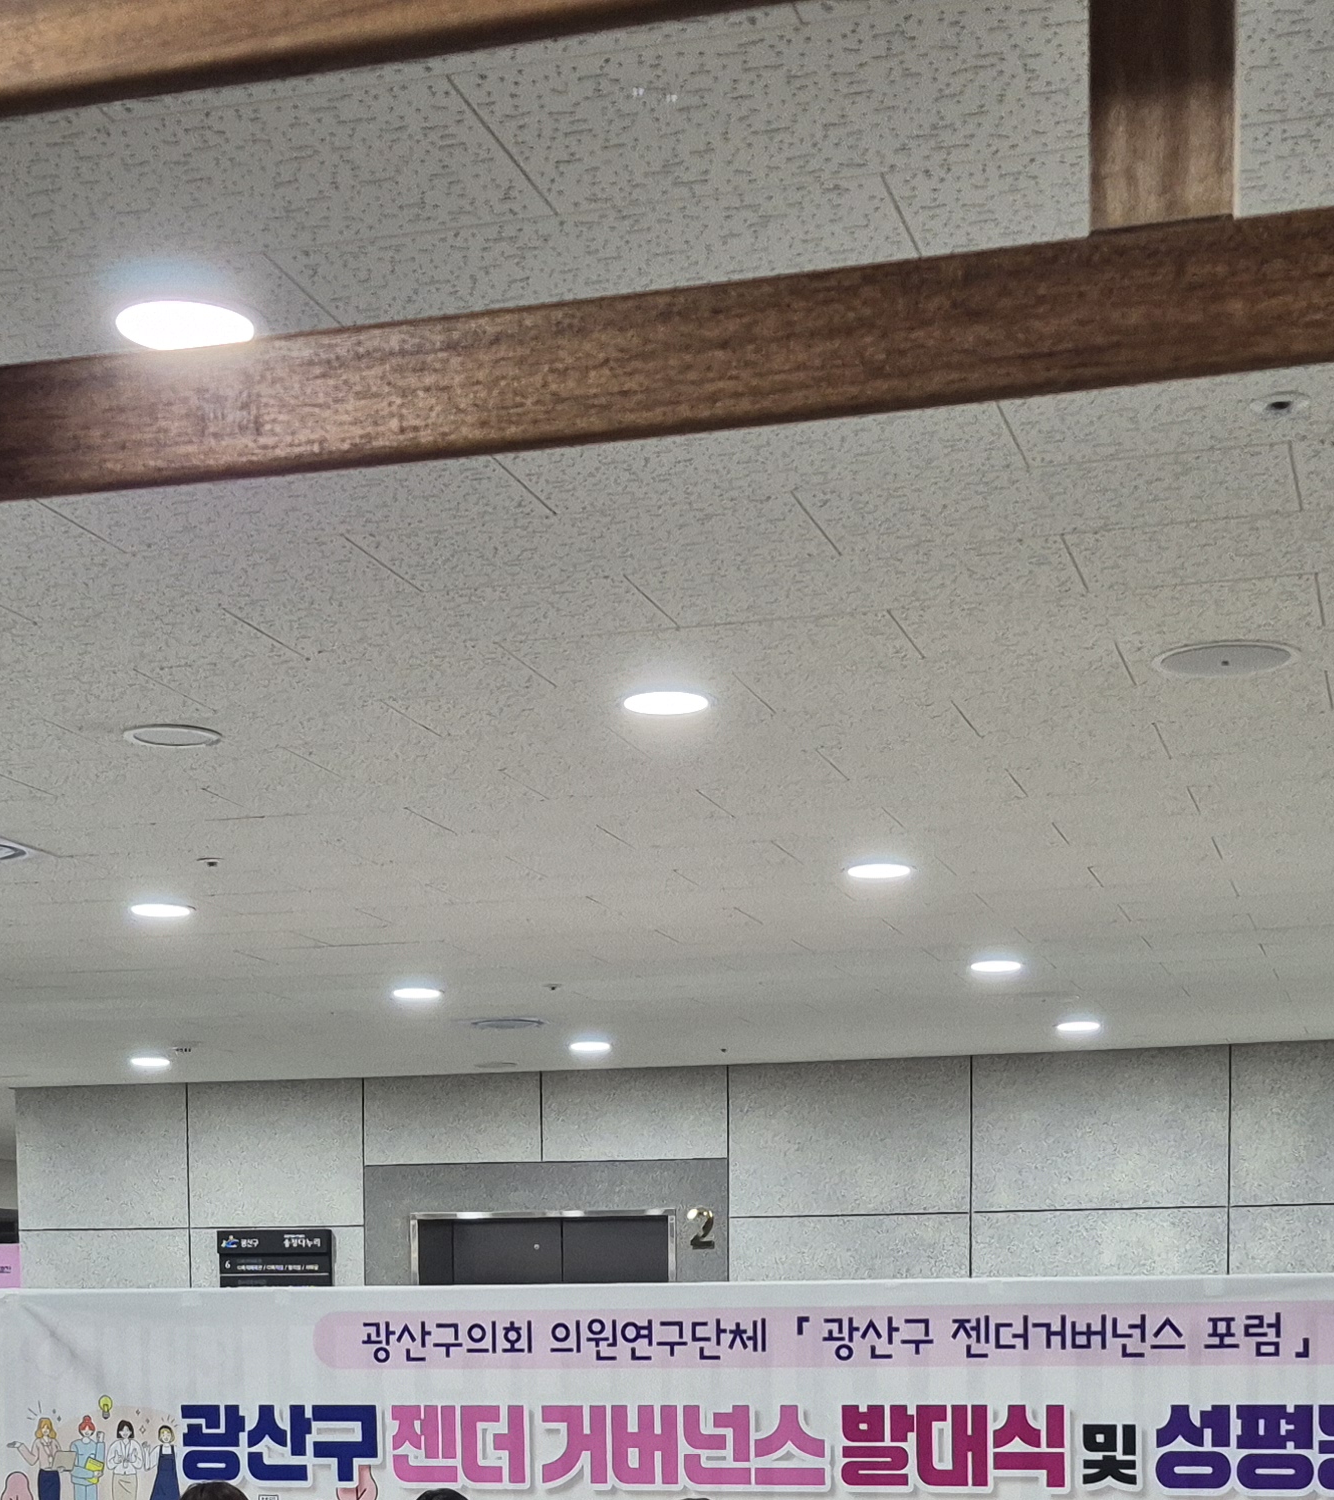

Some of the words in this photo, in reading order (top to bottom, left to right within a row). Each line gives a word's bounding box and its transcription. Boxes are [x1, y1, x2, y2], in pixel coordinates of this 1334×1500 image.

[224, 1260, 231, 1269] 6
[359, 1319, 535, 1364] 광산구의회
[549, 1316, 768, 1363] 의원연구단체
[951, 1312, 1186, 1356] 젠더거버넌스
[181, 1403, 378, 1486] 광산구
[389, 1404, 530, 1488] 젠더
[541, 1404, 829, 1488] 거버넌스
[840, 1404, 1068, 1490] 발대식
[1081, 1422, 1138, 1486] 및
